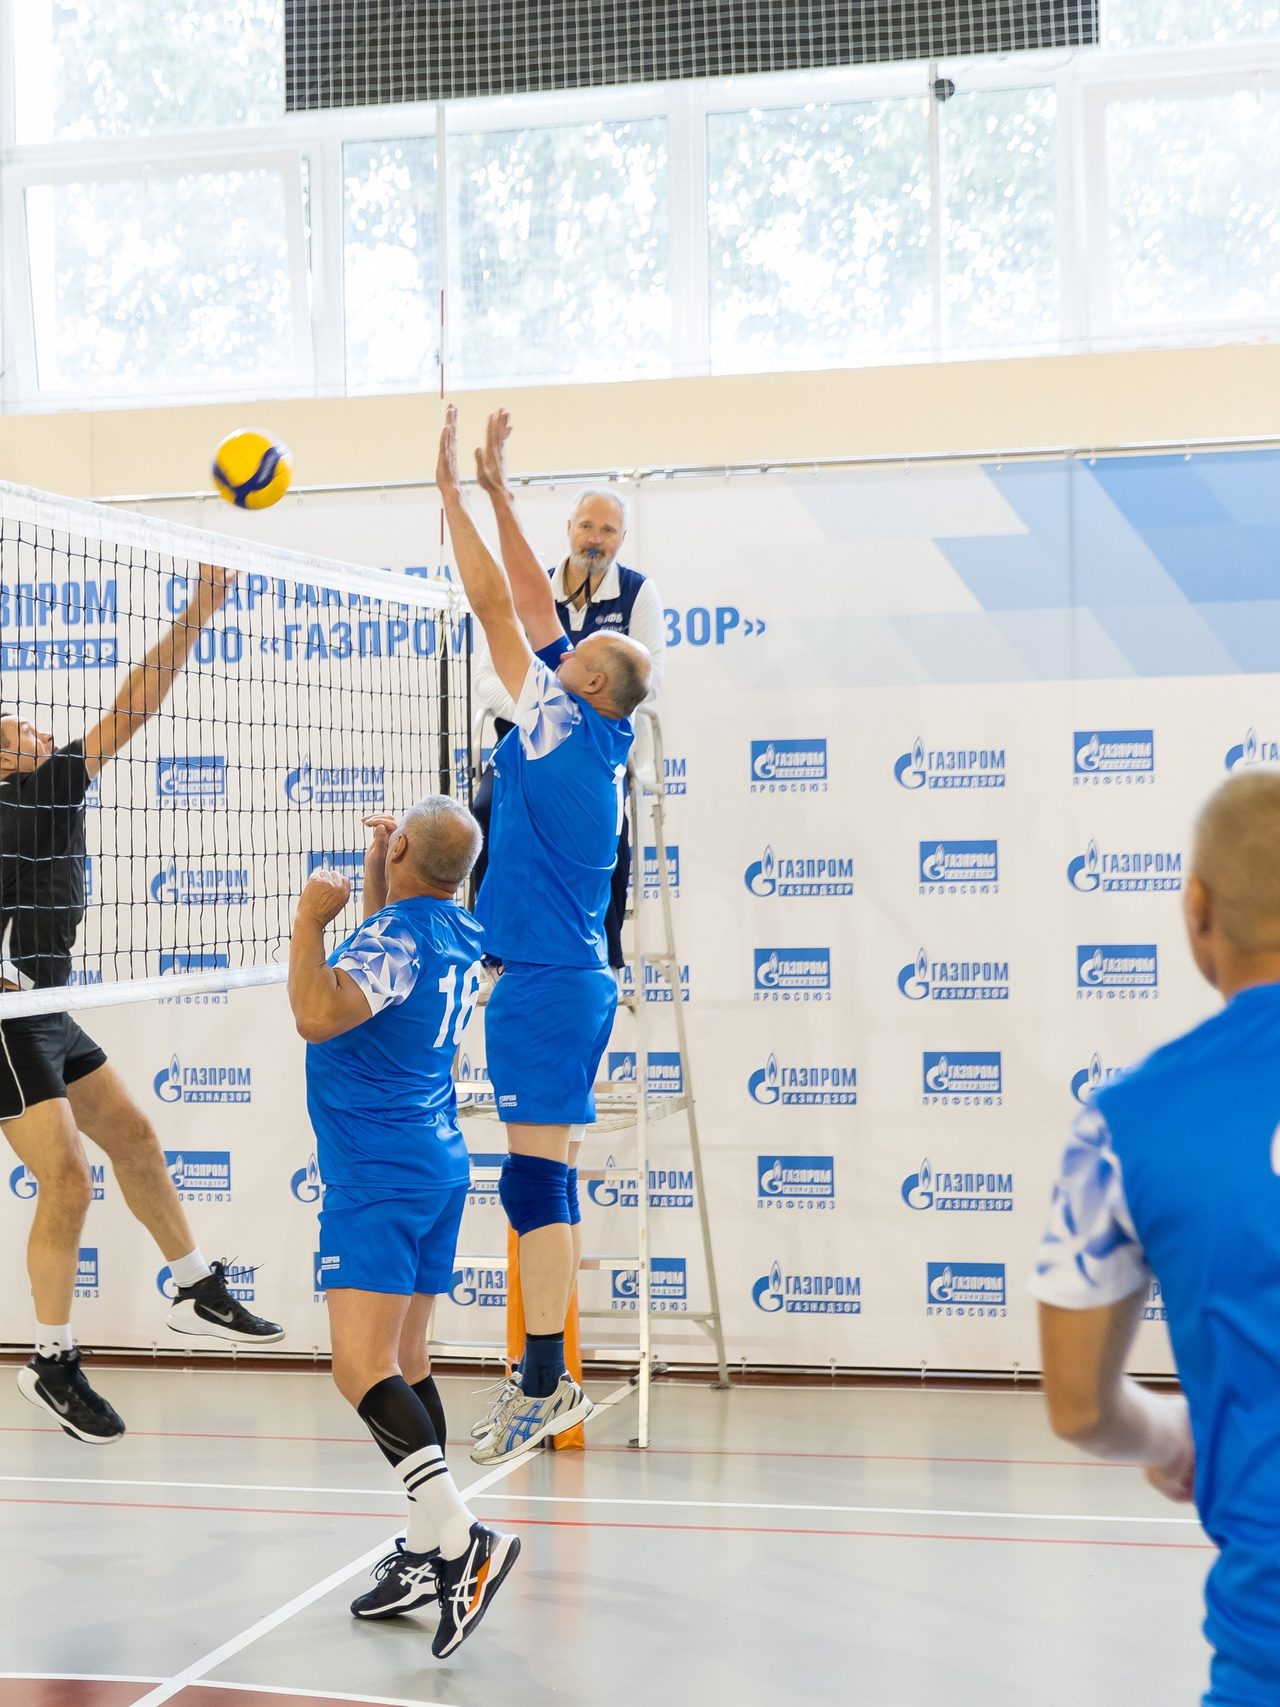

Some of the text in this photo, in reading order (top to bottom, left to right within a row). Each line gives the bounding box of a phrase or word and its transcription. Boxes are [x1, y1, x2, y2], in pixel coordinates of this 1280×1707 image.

[194, 625, 243, 665] ОО
[1100, 742, 1152, 758] ГАЗПРОМ
[776, 751, 824, 767] ГАЗПРОМ
[928, 750, 1005, 770] ГАЗПРОМ
[315, 767, 384, 786] ГАЗПРОМ
[930, 775, 1005, 788] ГАЗНАДЗОР
[1073, 775, 1155, 786] ПРОФСОЮЗ
[750, 783, 828, 794] ПРОФСОЮЗ
[945, 853, 996, 868] ГАЗПРОМ
[1102, 852, 1182, 873] ГАЗПРОМ
[778, 859, 853, 878] ГАЗПРОМ
[180, 869, 248, 888] ГАЗПРОМ
[1103, 878, 1181, 892] ГАЗНАДЗОР
[779, 883, 853, 896] ГАЗНАДЗОР
[919, 885, 999, 895] ПРОФСОЮЗ
[779, 961, 828, 976] ГАЗПРОМ
[1103, 957, 1155, 972] ГАЗПРОМ
[932, 962, 1009, 982] ГАЗПРОМ
[754, 992, 831, 1002] ПРОФСОЮЗ
[933, 987, 1009, 1000] ГАЗНАДЗОР
[1076, 990, 1159, 1000] ПРОФСОЮЗ
[183, 1068, 251, 1086] ГАЗПРОМ
[781, 1067, 857, 1087] ГАЗПРОМ
[948, 1065, 999, 1079] ГАЗПРОМ
[185, 1092, 250, 1103] ГАЗНАДЗОР
[782, 1092, 857, 1105] ГАЗНАДЗОР
[922, 1096, 1003, 1106] ПРОФСОЮЗ
[183, 1163, 228, 1177] ГАЗПРОМ
[782, 1169, 832, 1184] ГАЗПРОМ
[935, 1173, 1012, 1193] ГАЗПРОМ
[179, 1193, 231, 1202] ОФСОЮЗ
[621, 1196, 692, 1207] ГААДЗОР
[936, 1198, 1012, 1211] ГАЗНАДЗОР
[757, 1200, 835, 1210] ПРОФСОЮЗ
[785, 1276, 861, 1296] ГАЗПРОМ
[952, 1276, 1003, 1291] ГАЗПРОМ
[612, 1301, 687, 1311] ПРОСОЮЗ
[787, 1301, 860, 1314] ГАЗНАДЗОР
[927, 1307, 1007, 1317] ПРОФСОЮЗ
